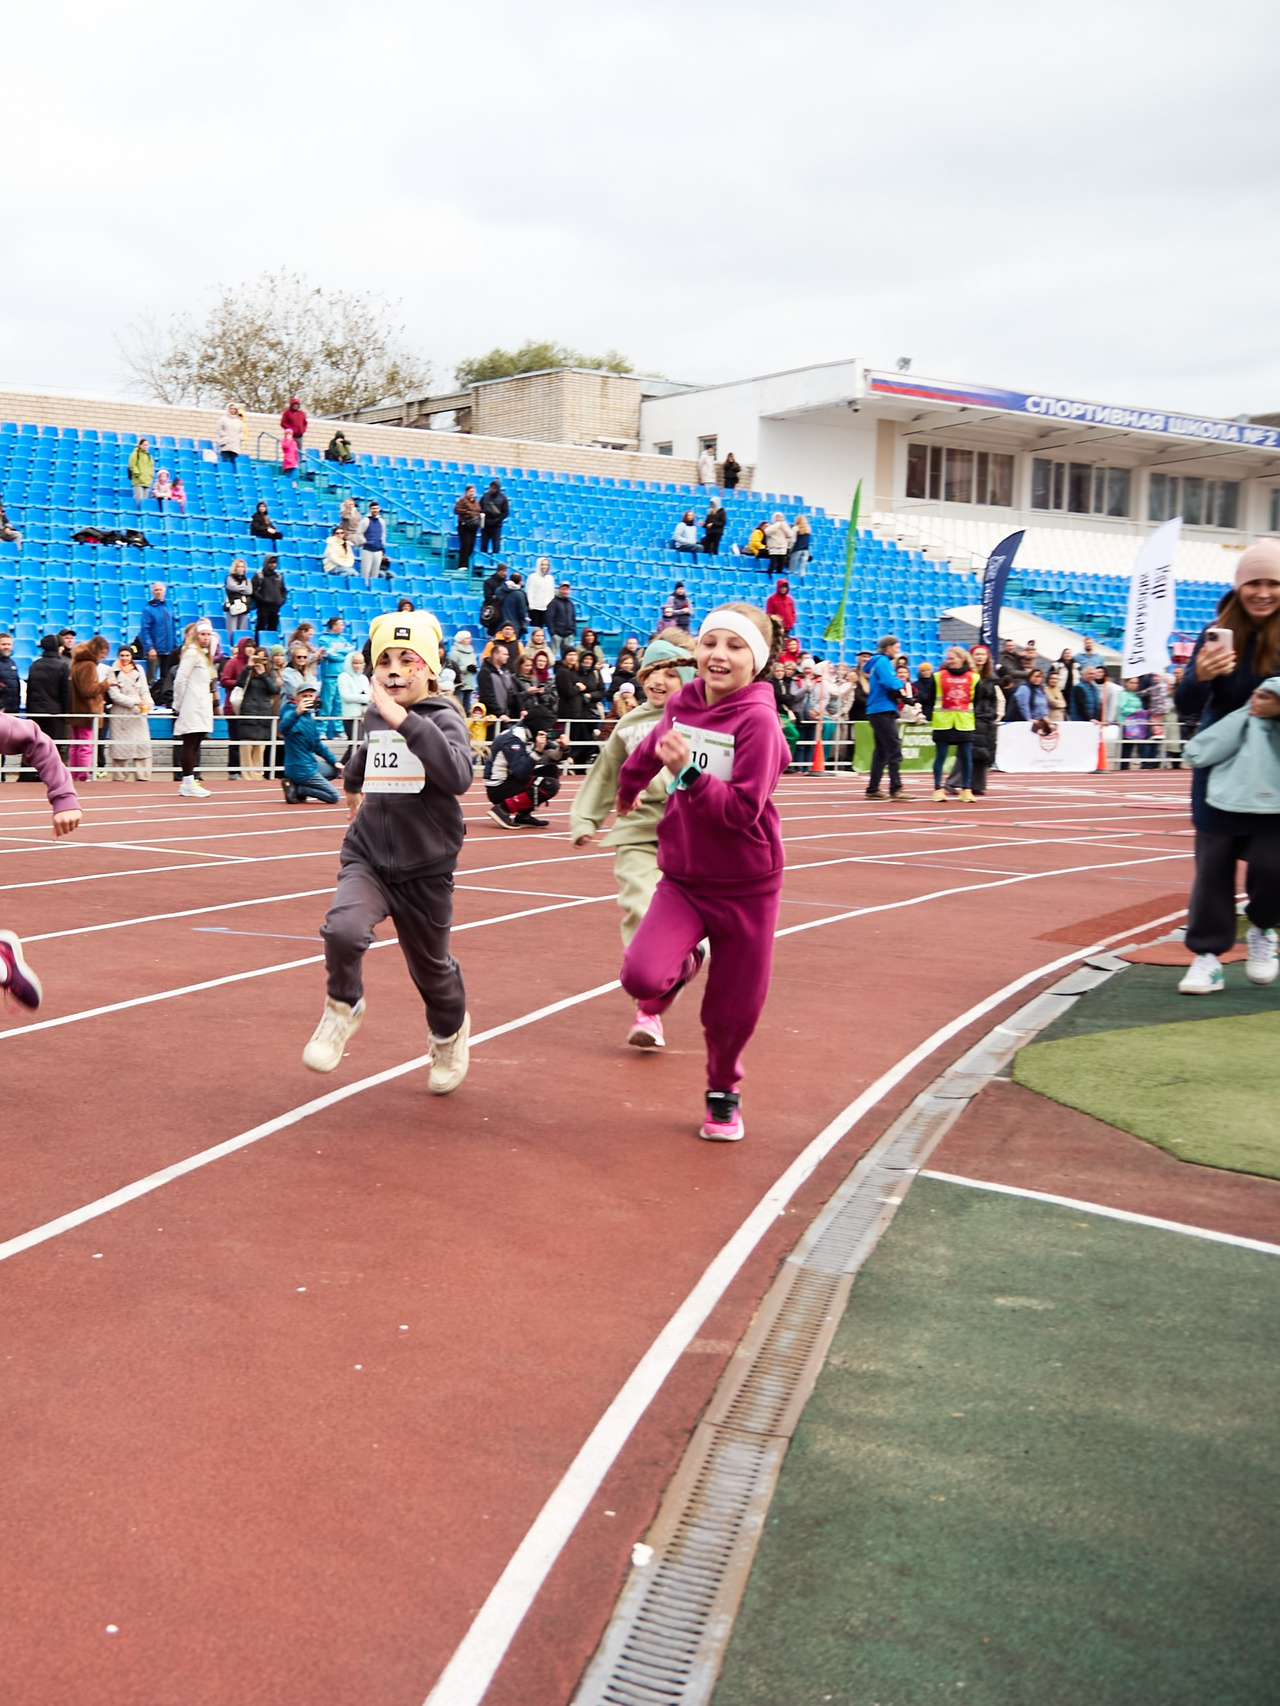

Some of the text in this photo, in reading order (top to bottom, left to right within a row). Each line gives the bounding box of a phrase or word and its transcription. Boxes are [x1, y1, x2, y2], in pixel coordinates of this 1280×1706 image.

[1025, 396, 1278, 446] СПОРТИВНАЯ ШКОЛА №2
[373, 752, 399, 768] 612
[691, 750, 708, 769] 10
